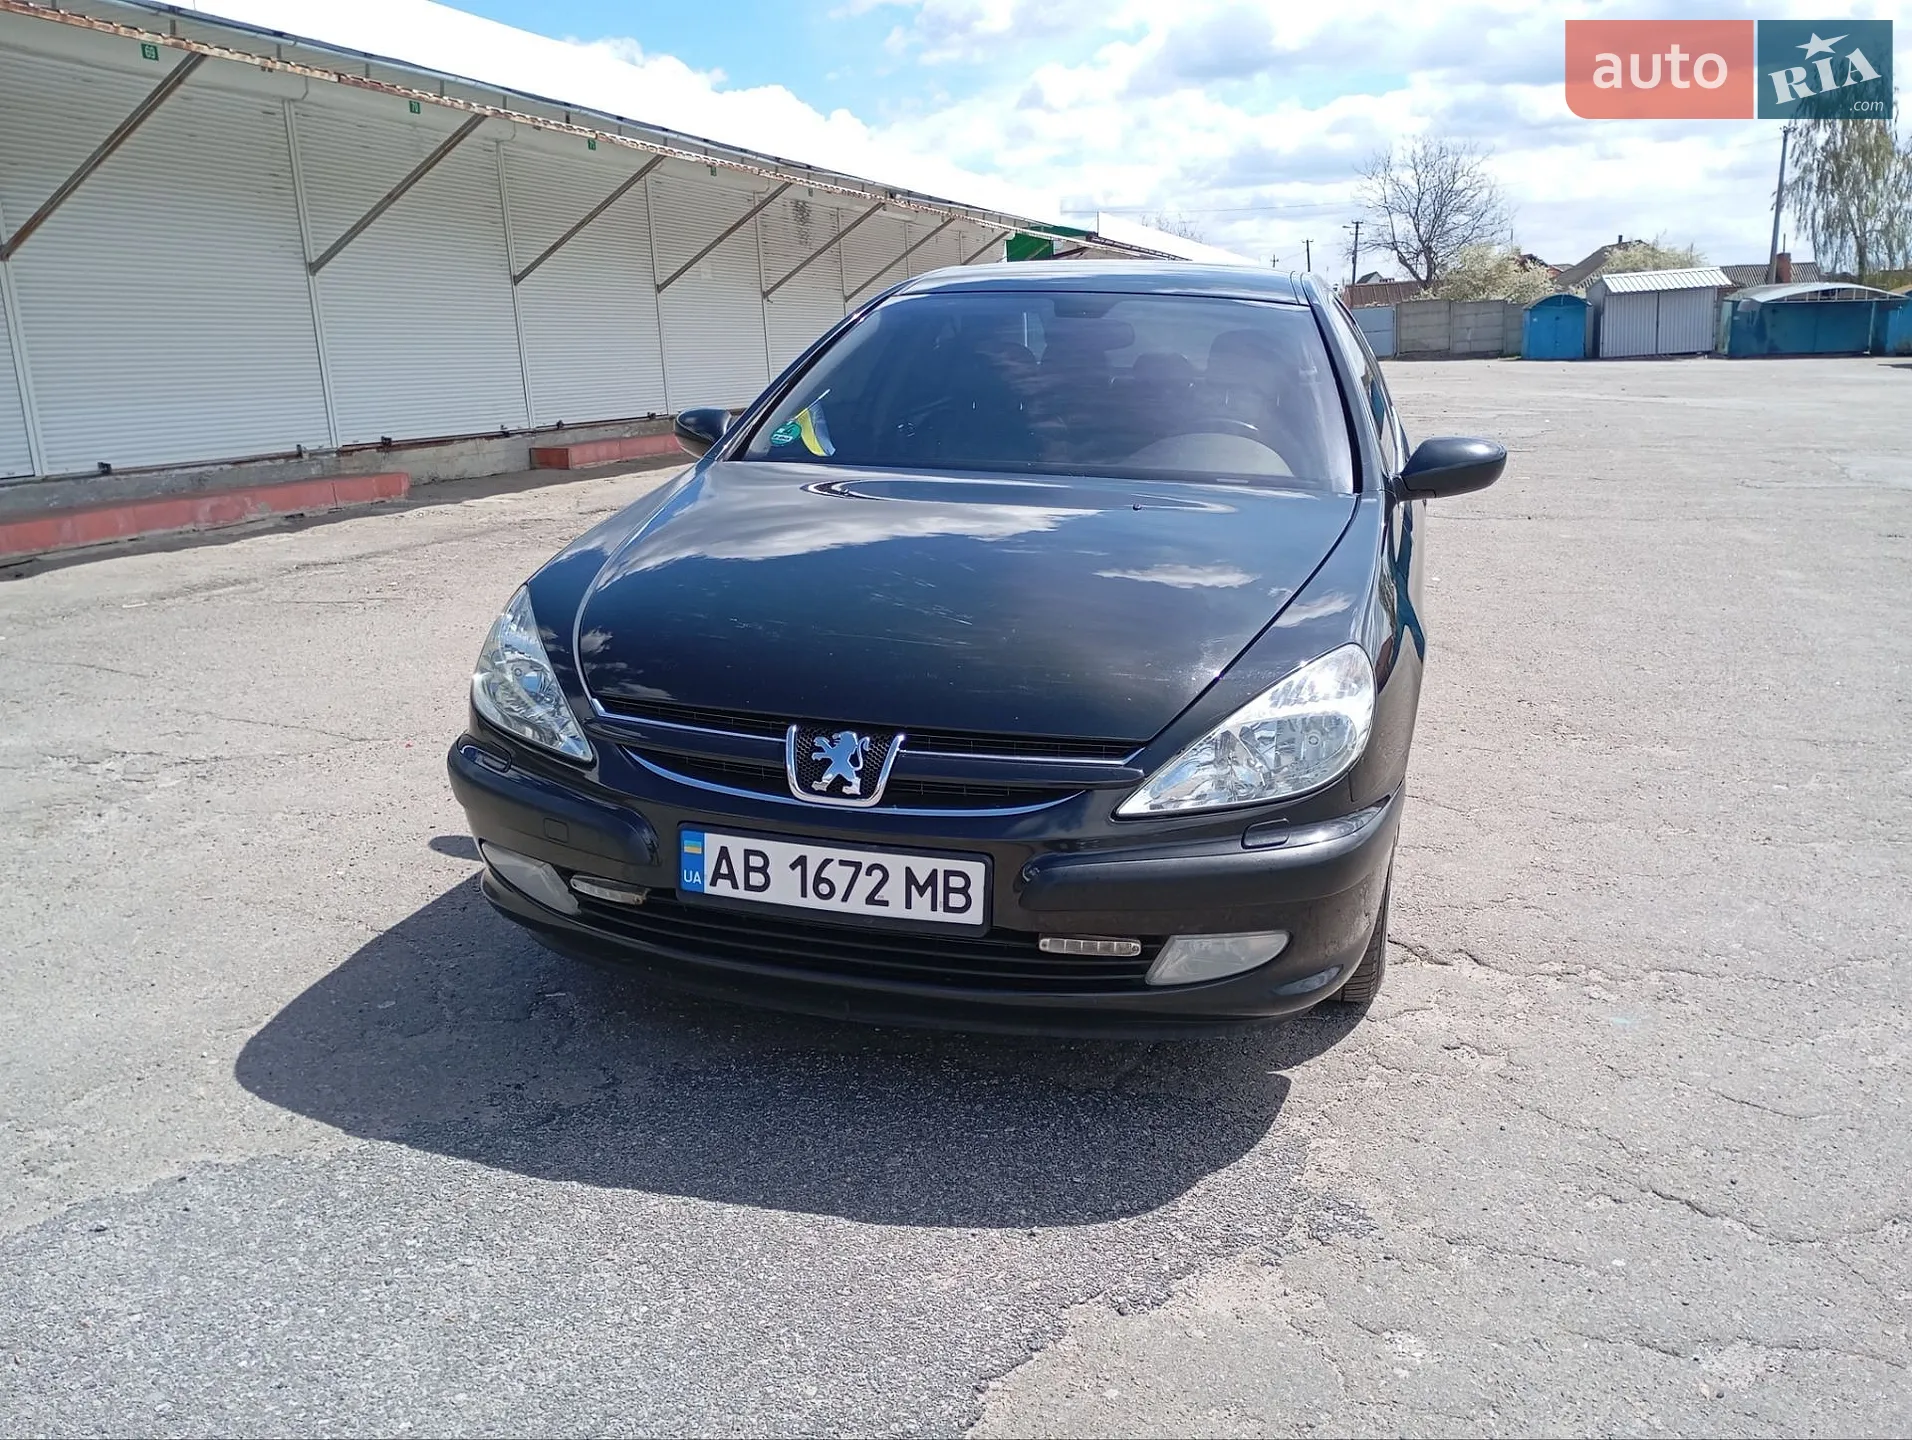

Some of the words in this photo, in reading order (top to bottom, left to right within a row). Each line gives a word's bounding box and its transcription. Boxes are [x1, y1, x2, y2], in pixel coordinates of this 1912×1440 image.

[683, 870, 702, 885] UA
[709, 845, 771, 893] AB
[788, 855, 890, 907] 1672
[904, 866, 972, 914] MB
